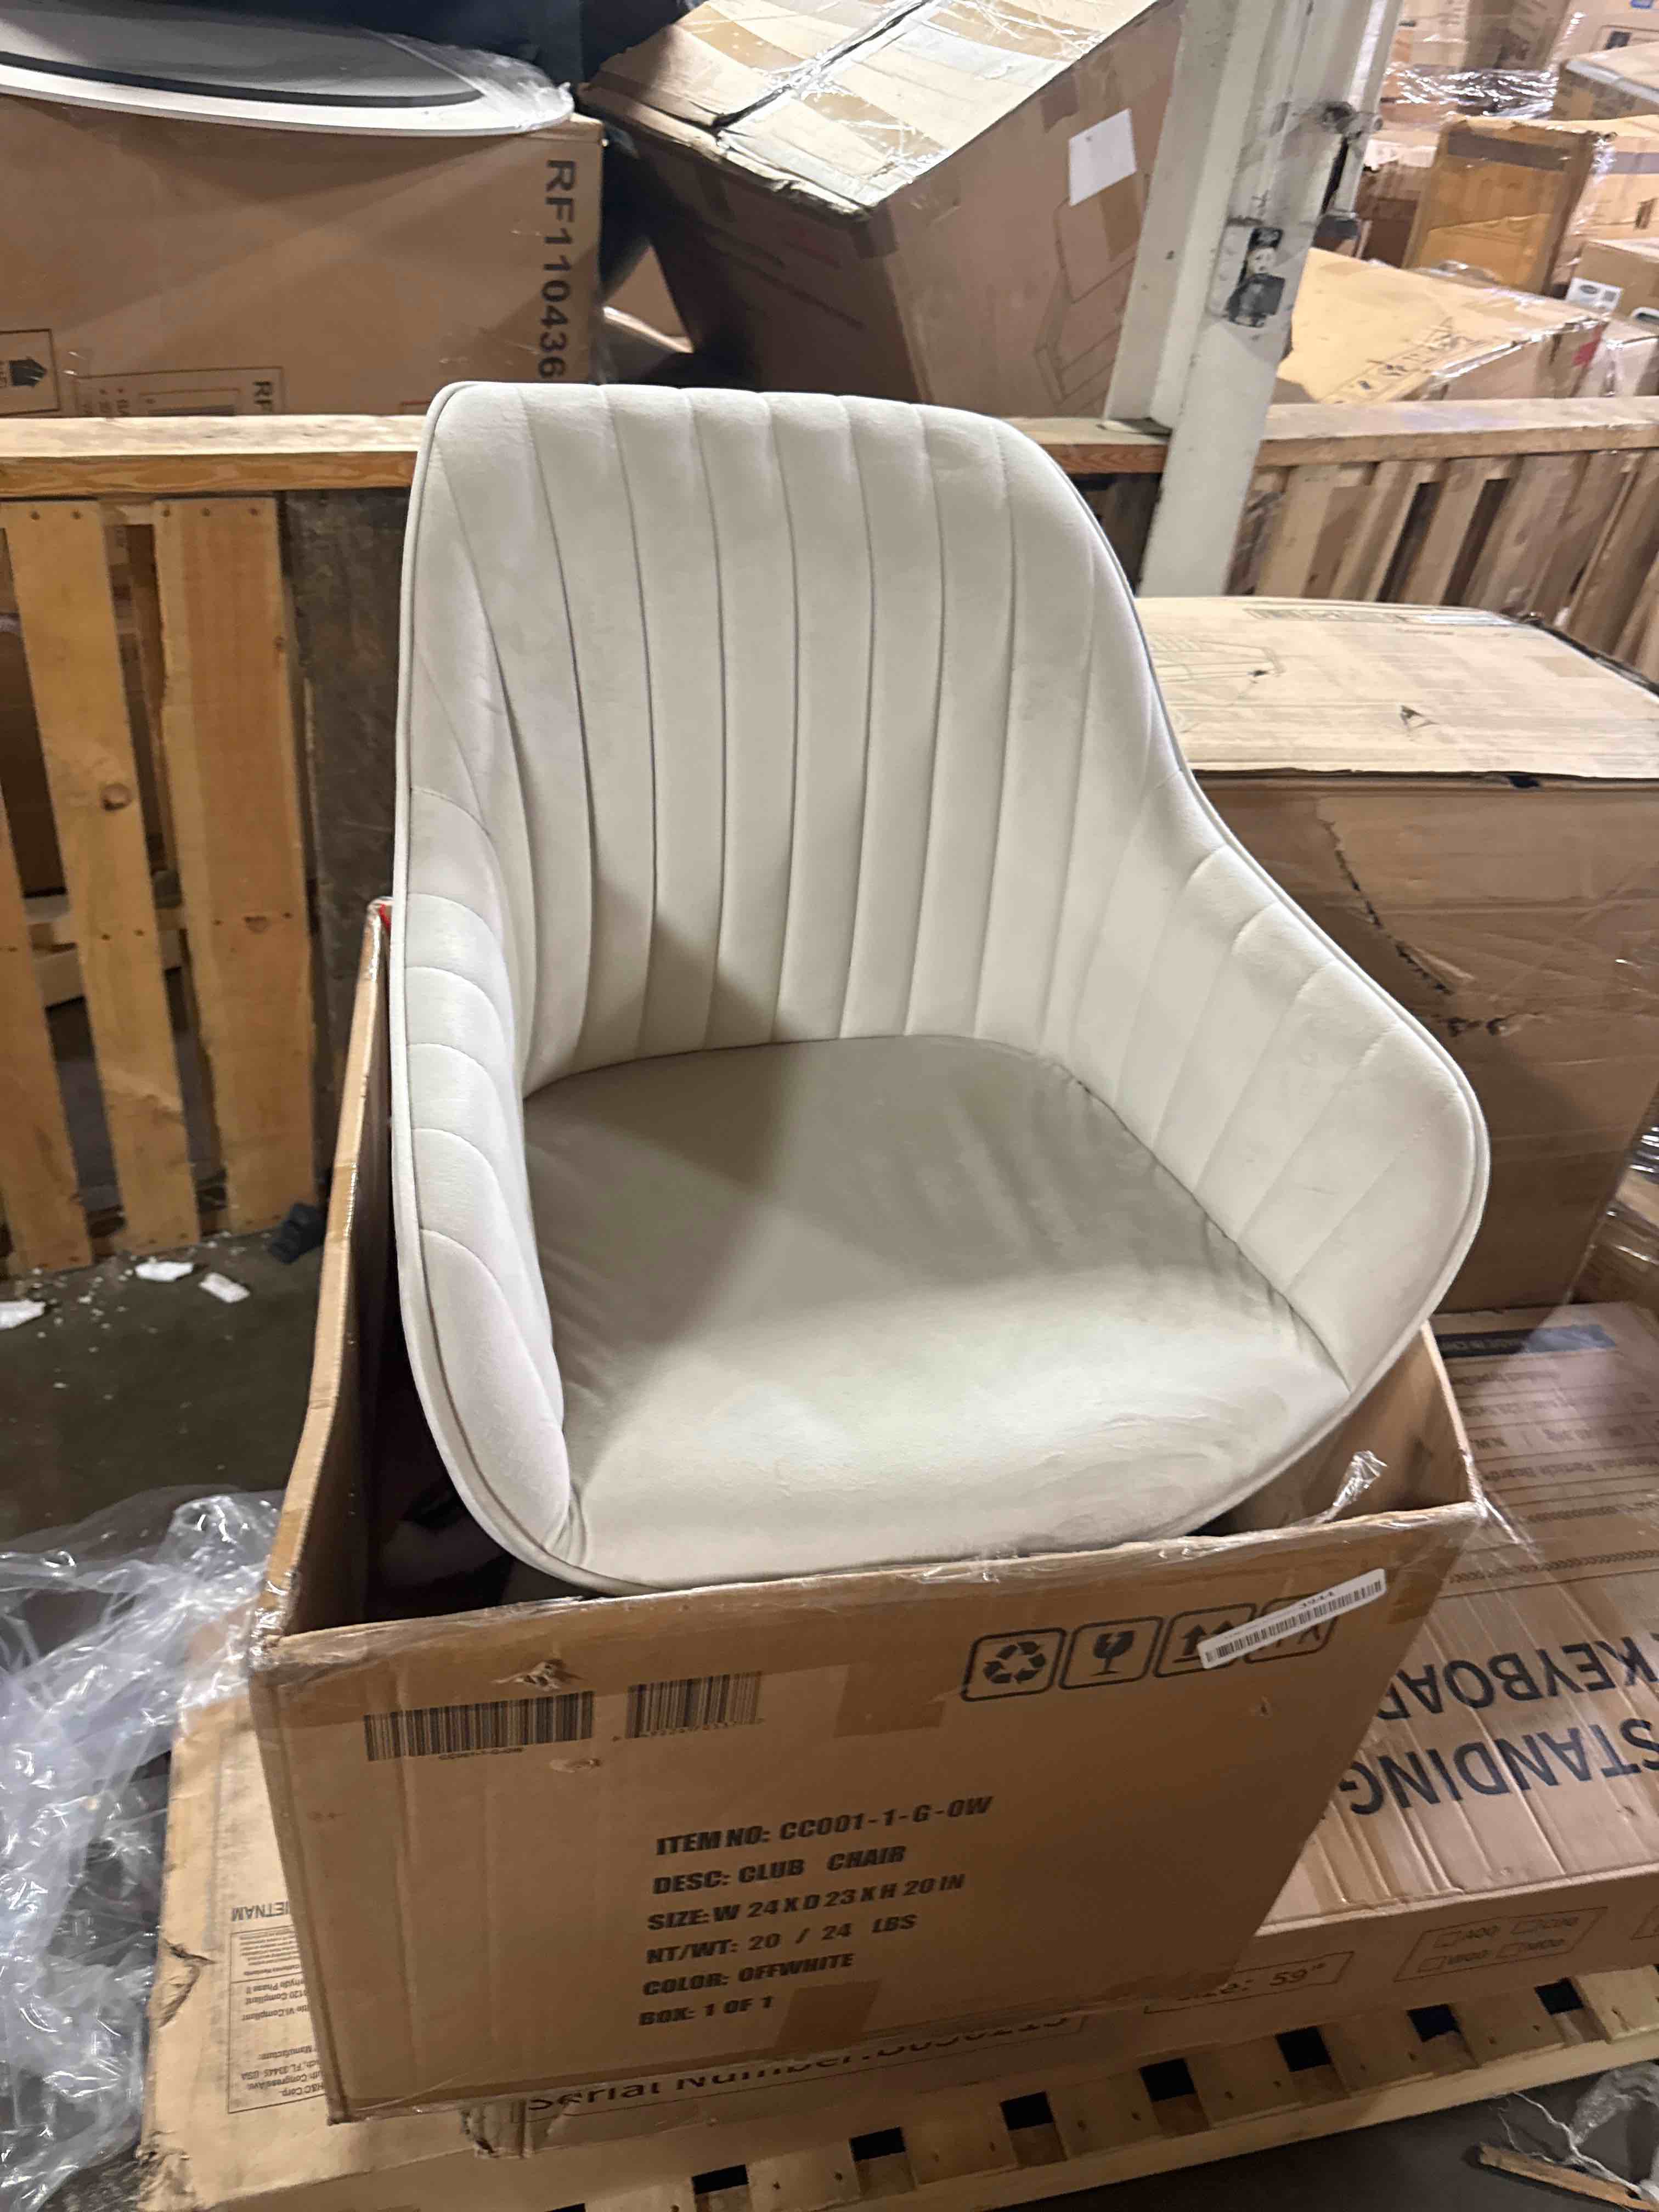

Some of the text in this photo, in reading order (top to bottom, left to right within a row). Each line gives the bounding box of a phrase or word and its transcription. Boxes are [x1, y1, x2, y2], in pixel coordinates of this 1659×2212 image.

[537, 159, 575, 380] RF110436
[1375, 1636, 1656, 1722] KEYBOA
[1337, 1718, 1659, 1816] STANDING
[657, 1830, 722, 1855] ITEM
[725, 1825, 771, 1847] NO:
[652, 1846, 907, 1894] DESC: CLUB CHAIR
[231, 1901, 290, 1923] IETNAM
[748, 1933, 781, 1950] 20
[795, 1927, 810, 1944] /
[821, 1922, 852, 1940] 24
[871, 1913, 918, 1933] LBS
[643, 1953, 856, 1995] COLOR: OFFWHITE
[638, 1995, 775, 2025] BOX: 1 OF 1
